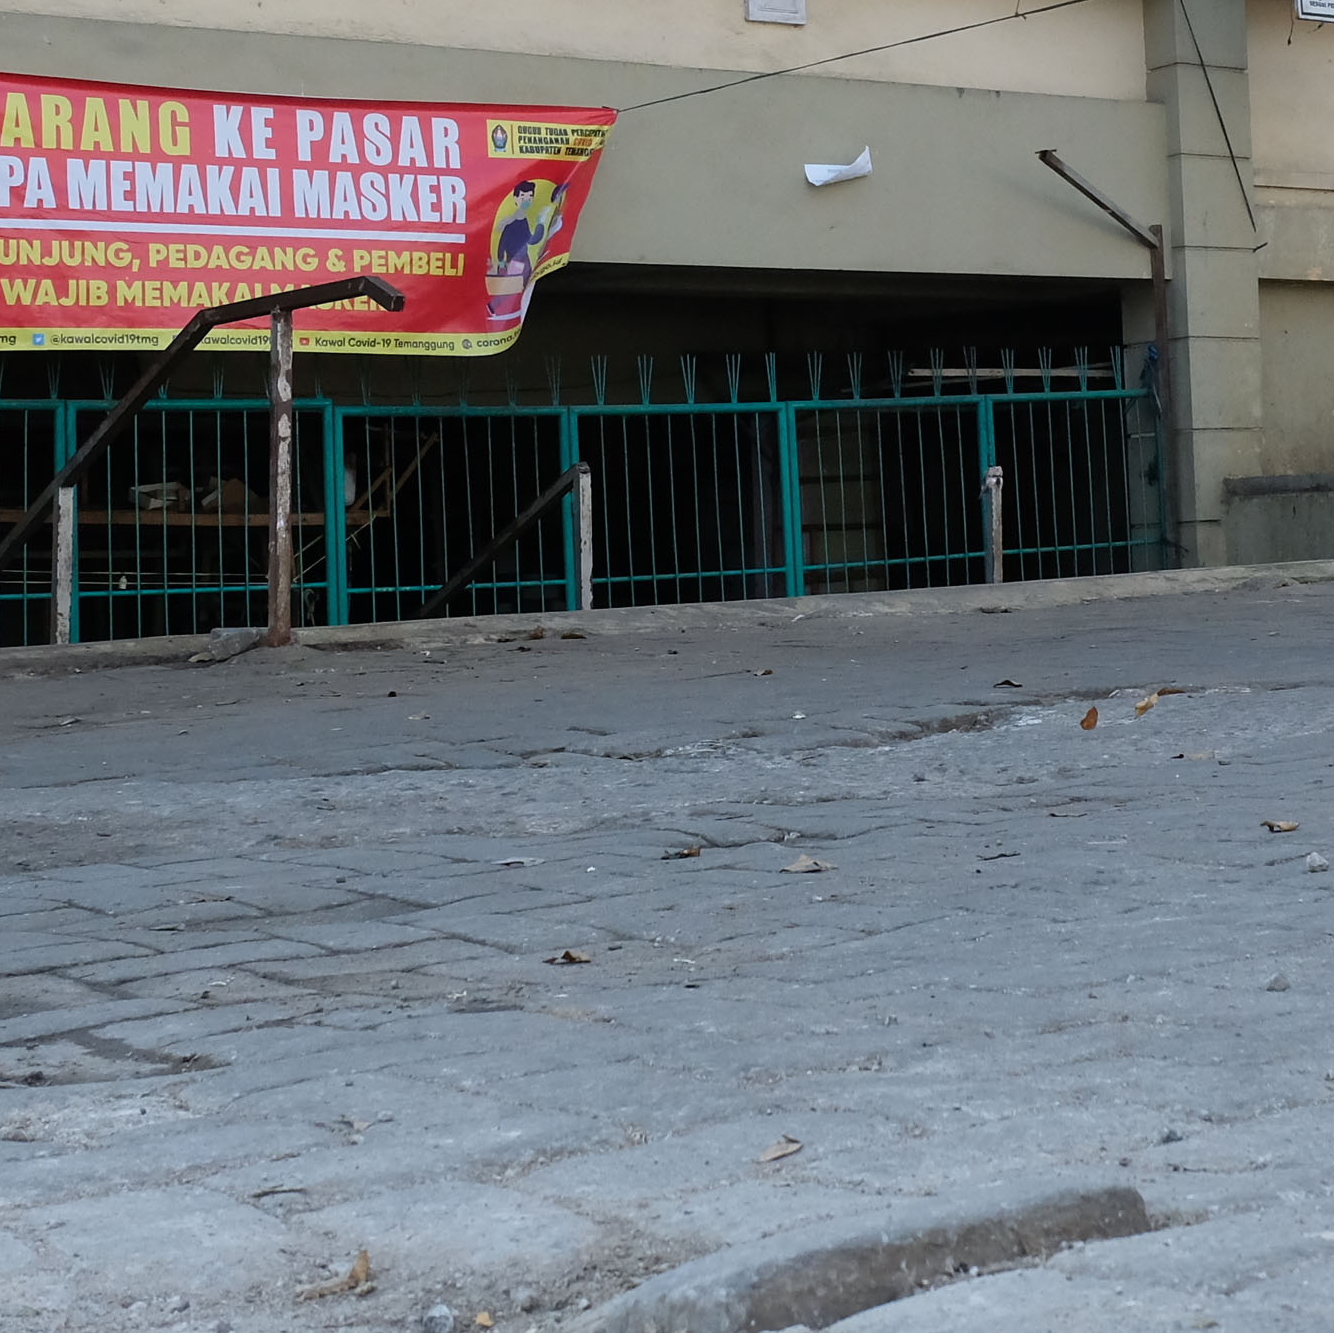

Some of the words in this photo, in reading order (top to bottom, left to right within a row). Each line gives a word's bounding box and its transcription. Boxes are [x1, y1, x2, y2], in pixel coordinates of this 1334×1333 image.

[213, 104, 276, 161] KE
[296, 109, 461, 169] PASAR
[518, 137, 569, 145] PENANGANAN
[519, 146, 561, 155] KABUPATEN
[67, 158, 281, 217] MEMAKAI
[292, 170, 466, 223] MASKER
[149, 243, 318, 271] PEDAGANG
[326, 247, 346, 273] &
[353, 248, 465, 277] PEMBELI
[0, 278, 109, 306] WAJIB
[116, 280, 267, 308] MEMAKAI
[50, 333, 159, 347] @kawalcovid19tmg
[315, 336, 346, 347] Kawal
[348, 336, 391, 348] Covid-19
[394, 338, 455, 351] Temanggung
